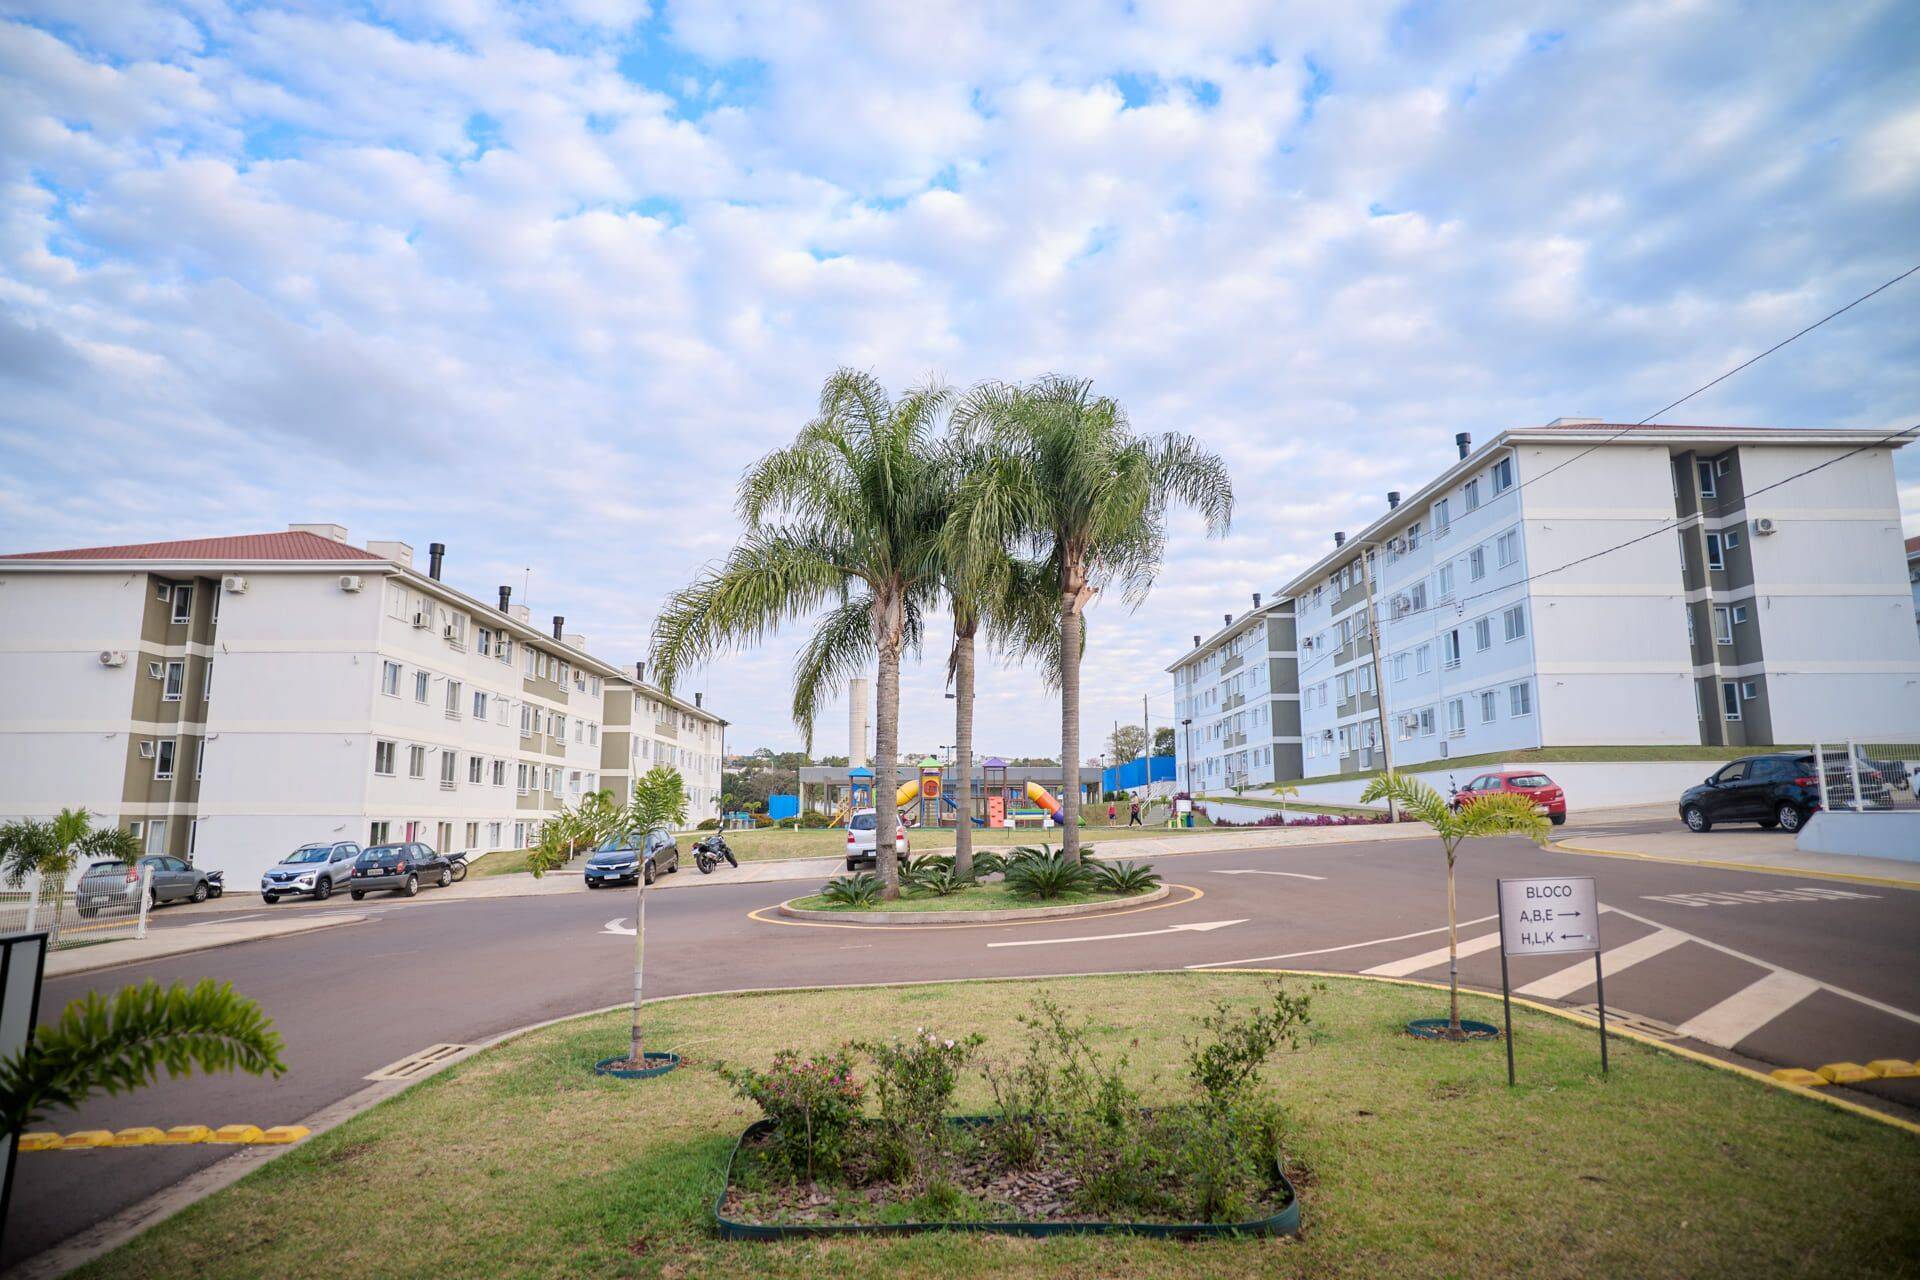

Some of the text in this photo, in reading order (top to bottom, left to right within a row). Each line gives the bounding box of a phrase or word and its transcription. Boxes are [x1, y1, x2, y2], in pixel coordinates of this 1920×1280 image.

[1526, 885, 1572, 899] BLOCO
[1520, 909, 1553, 923] A,B,E
[1521, 931, 1555, 946] H,L,K
